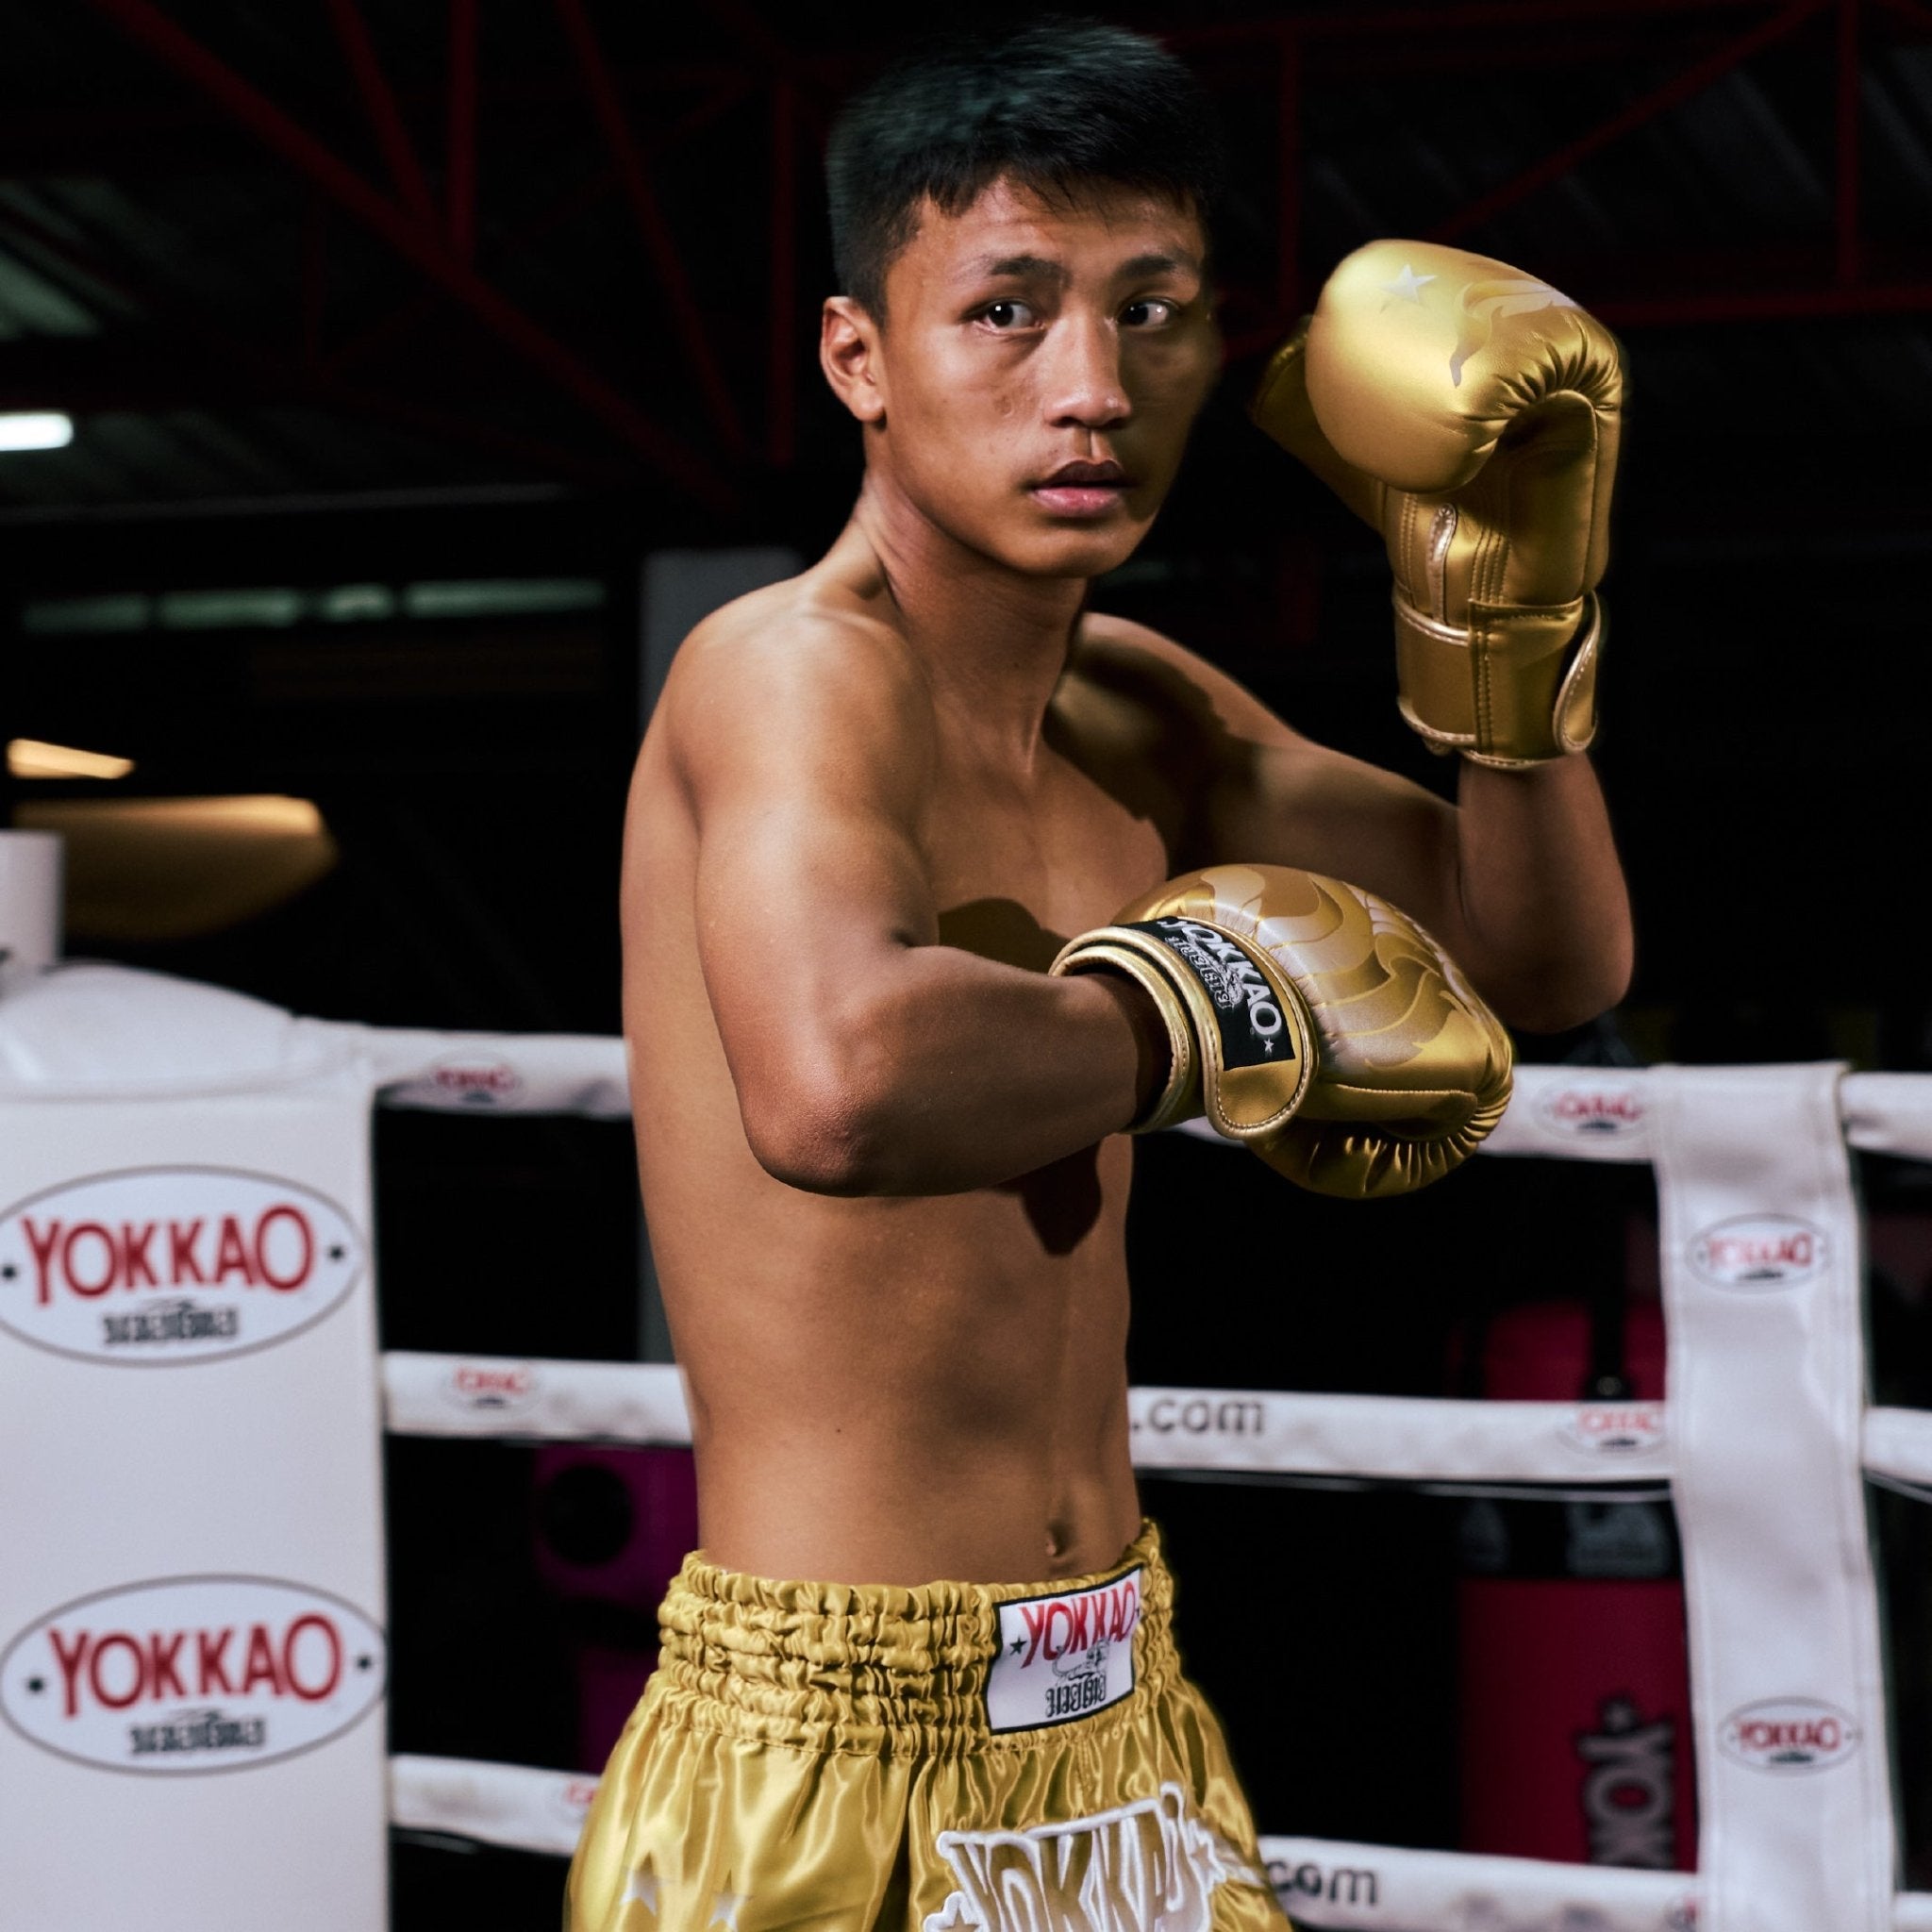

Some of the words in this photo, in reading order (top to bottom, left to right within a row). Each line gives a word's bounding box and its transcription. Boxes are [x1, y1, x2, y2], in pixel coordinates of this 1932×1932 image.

[21, 1203, 315, 1306] YOKKAO
[1132, 1399, 1266, 1436] .com
[49, 1613, 342, 1718] YOKKAO
[1020, 1582, 1135, 1669] YOKKAO
